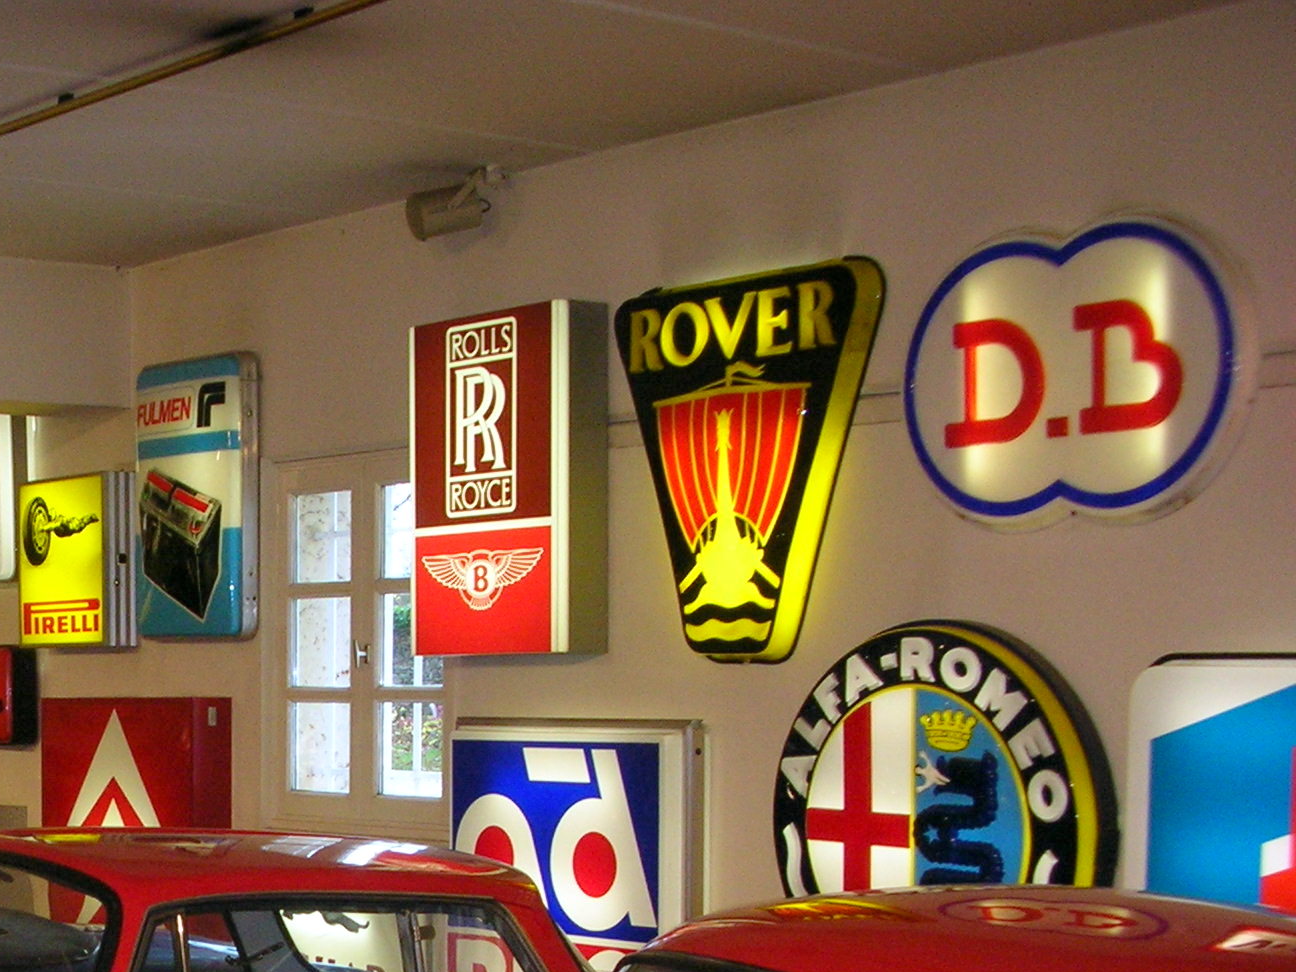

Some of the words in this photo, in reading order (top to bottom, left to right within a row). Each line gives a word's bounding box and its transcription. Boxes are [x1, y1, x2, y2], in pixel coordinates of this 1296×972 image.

[450, 324, 512, 361] ROLLS
[630, 280, 837, 374] ROVER
[944, 298, 1184, 449] D.B
[137, 396, 192, 427] FULMEN
[450, 478, 511, 511] ROYCE
[473, 564, 489, 592] B
[22, 598, 100, 636] PIRELLI
[780, 636, 1069, 824] ALFA-ROMEO
